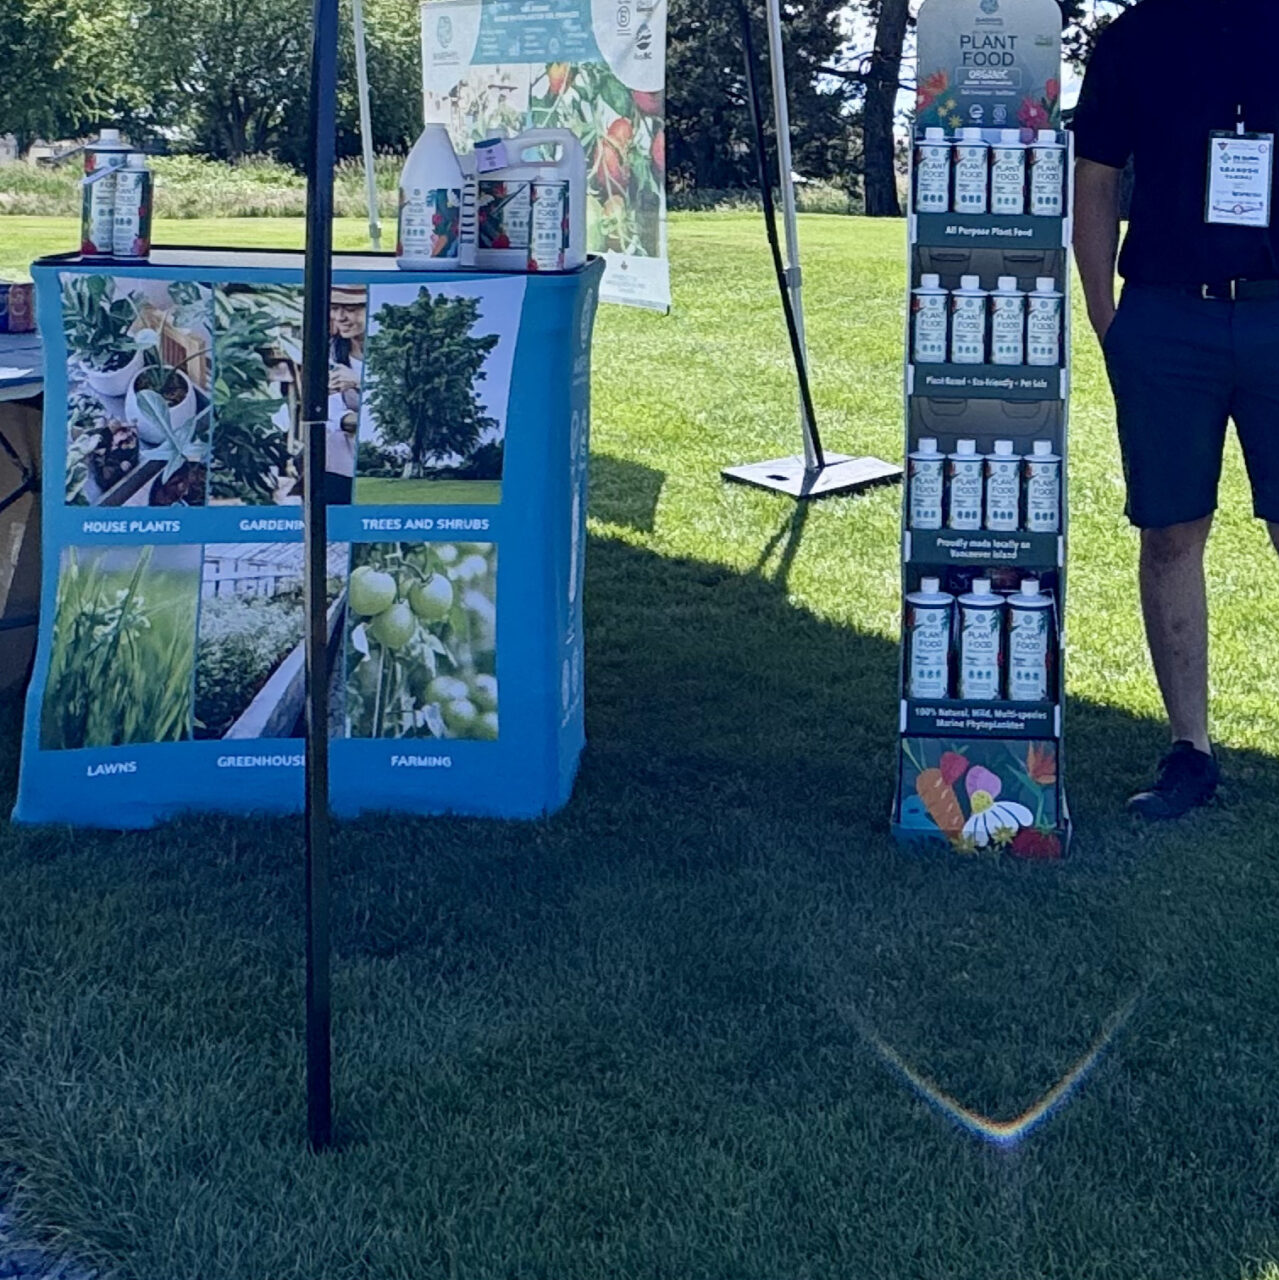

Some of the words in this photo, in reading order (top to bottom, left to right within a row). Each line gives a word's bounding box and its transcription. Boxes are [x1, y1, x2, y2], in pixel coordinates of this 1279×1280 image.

[960, 35, 1018, 50] PLANT
[962, 52, 1015, 67] FOOD
[968, 70, 1009, 80] ORGANIC
[945, 226, 957, 234] All
[958, 226, 990, 237] Purpose
[991, 227, 1012, 236] Plant
[1013, 227, 1033, 237] Food
[83, 521, 127, 532] HOUSE
[130, 520, 181, 532] PLANTS
[361, 519, 401, 530] TREES
[403, 519, 433, 530] AND
[436, 519, 490, 530] SHRUBS
[969, 539, 991, 548] made
[950, 549, 991, 559] Vancouver
[993, 550, 1017, 559] Island
[391, 755, 453, 767] FARMING
[87, 761, 137, 777] LAWNS
